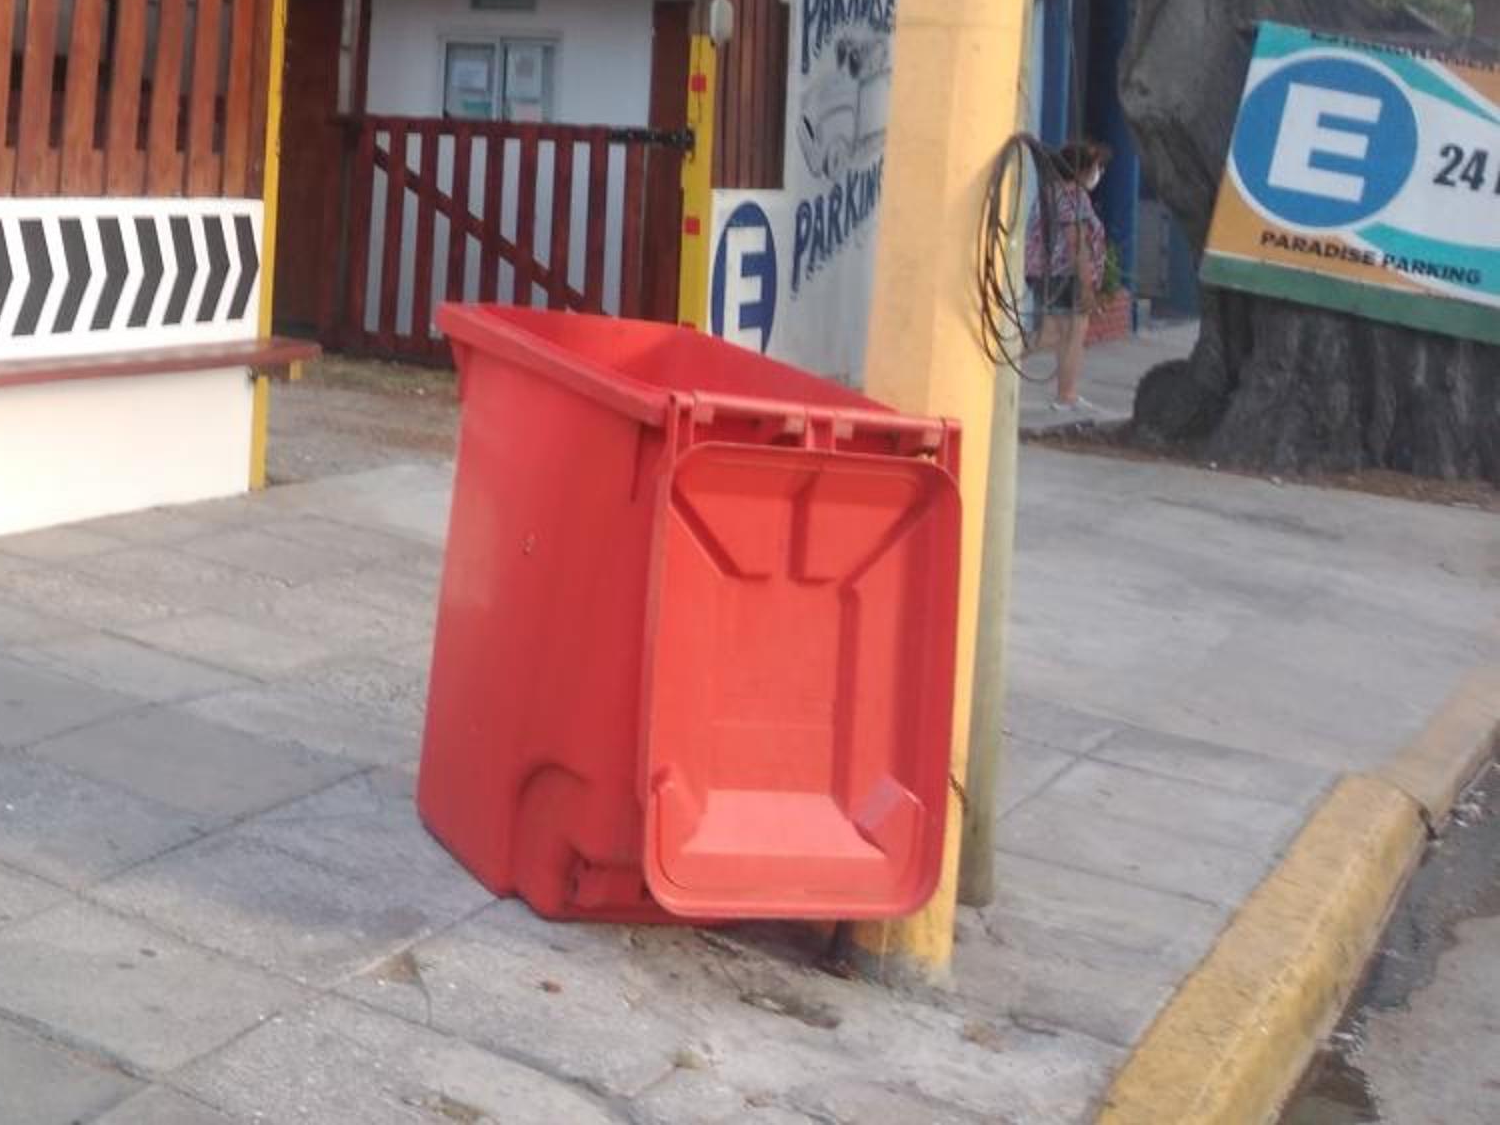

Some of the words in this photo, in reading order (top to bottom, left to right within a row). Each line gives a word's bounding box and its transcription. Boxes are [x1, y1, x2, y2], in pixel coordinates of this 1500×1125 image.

[1267, 82, 1382, 203] E
[1433, 142, 1488, 192] 24
[723, 226, 767, 353] E
[1260, 229, 1377, 268] PARADISE
[1381, 251, 1482, 286] PARKING
